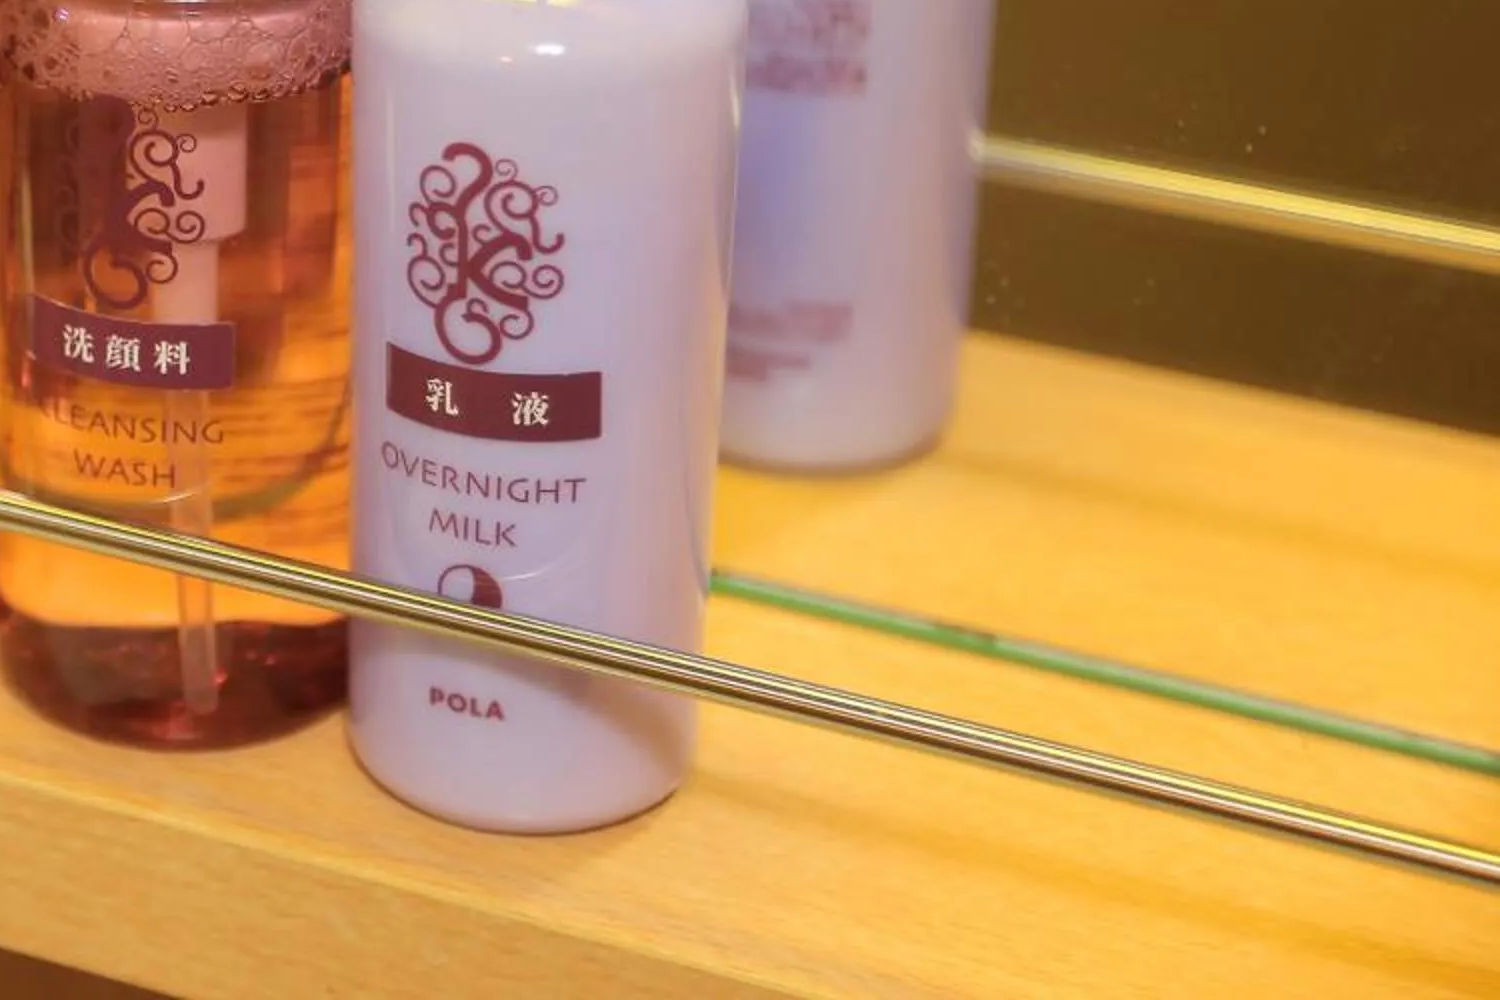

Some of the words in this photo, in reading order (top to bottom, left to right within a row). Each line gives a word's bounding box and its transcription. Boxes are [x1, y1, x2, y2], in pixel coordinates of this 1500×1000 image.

[62, 323, 191, 375] 洗顔料
[424, 377, 550, 427] 乳液
[73, 447, 176, 490] WASH
[380, 440, 587, 505] OVERNIGHT
[428, 508, 518, 548] MILK
[428, 685, 506, 722] POLA
